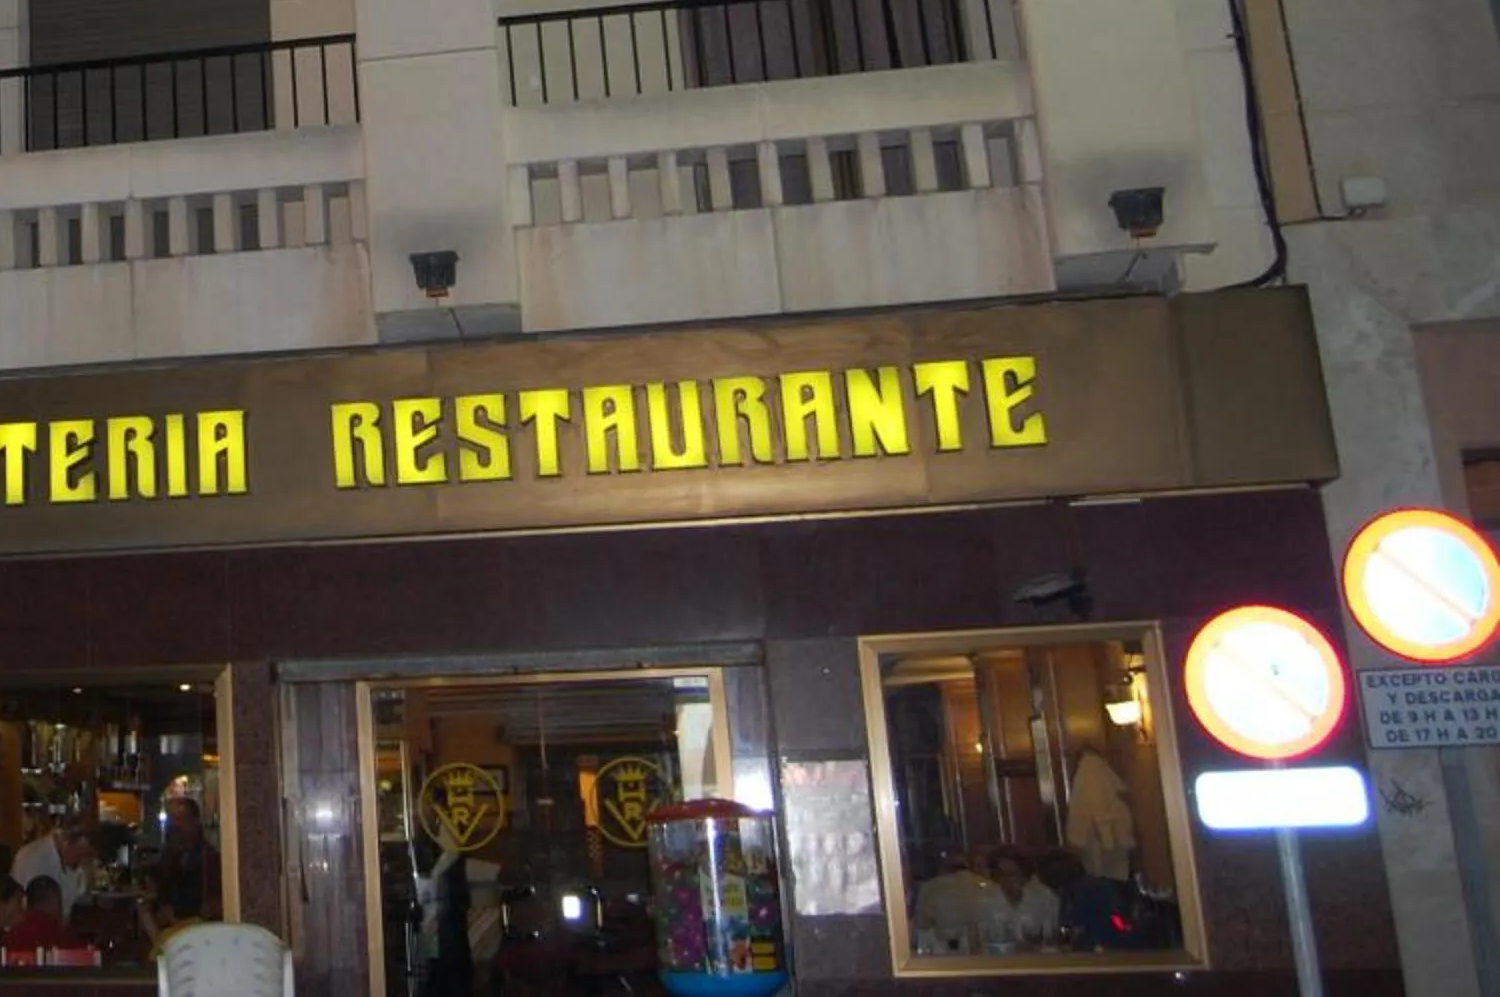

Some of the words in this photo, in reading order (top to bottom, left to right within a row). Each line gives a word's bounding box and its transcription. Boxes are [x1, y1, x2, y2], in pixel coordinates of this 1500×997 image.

[330, 355, 1048, 489] RESTAURANTE
[1366, 673, 1447, 688] EXCEPTO
[1387, 691, 1397, 705] Y
[1404, 688, 1500, 705] DESCARGA
[1380, 710, 1402, 725] DE
[1423, 709, 1437, 723] H
[1443, 708, 1455, 722] A
[1485, 706, 1498, 720] H
[1385, 728, 1409, 743] DE
[1415, 727, 1431, 741] 17
[1436, 726, 1450, 740] H
[1457, 726, 1468, 740] A
[1474, 725, 1498, 740] 20
